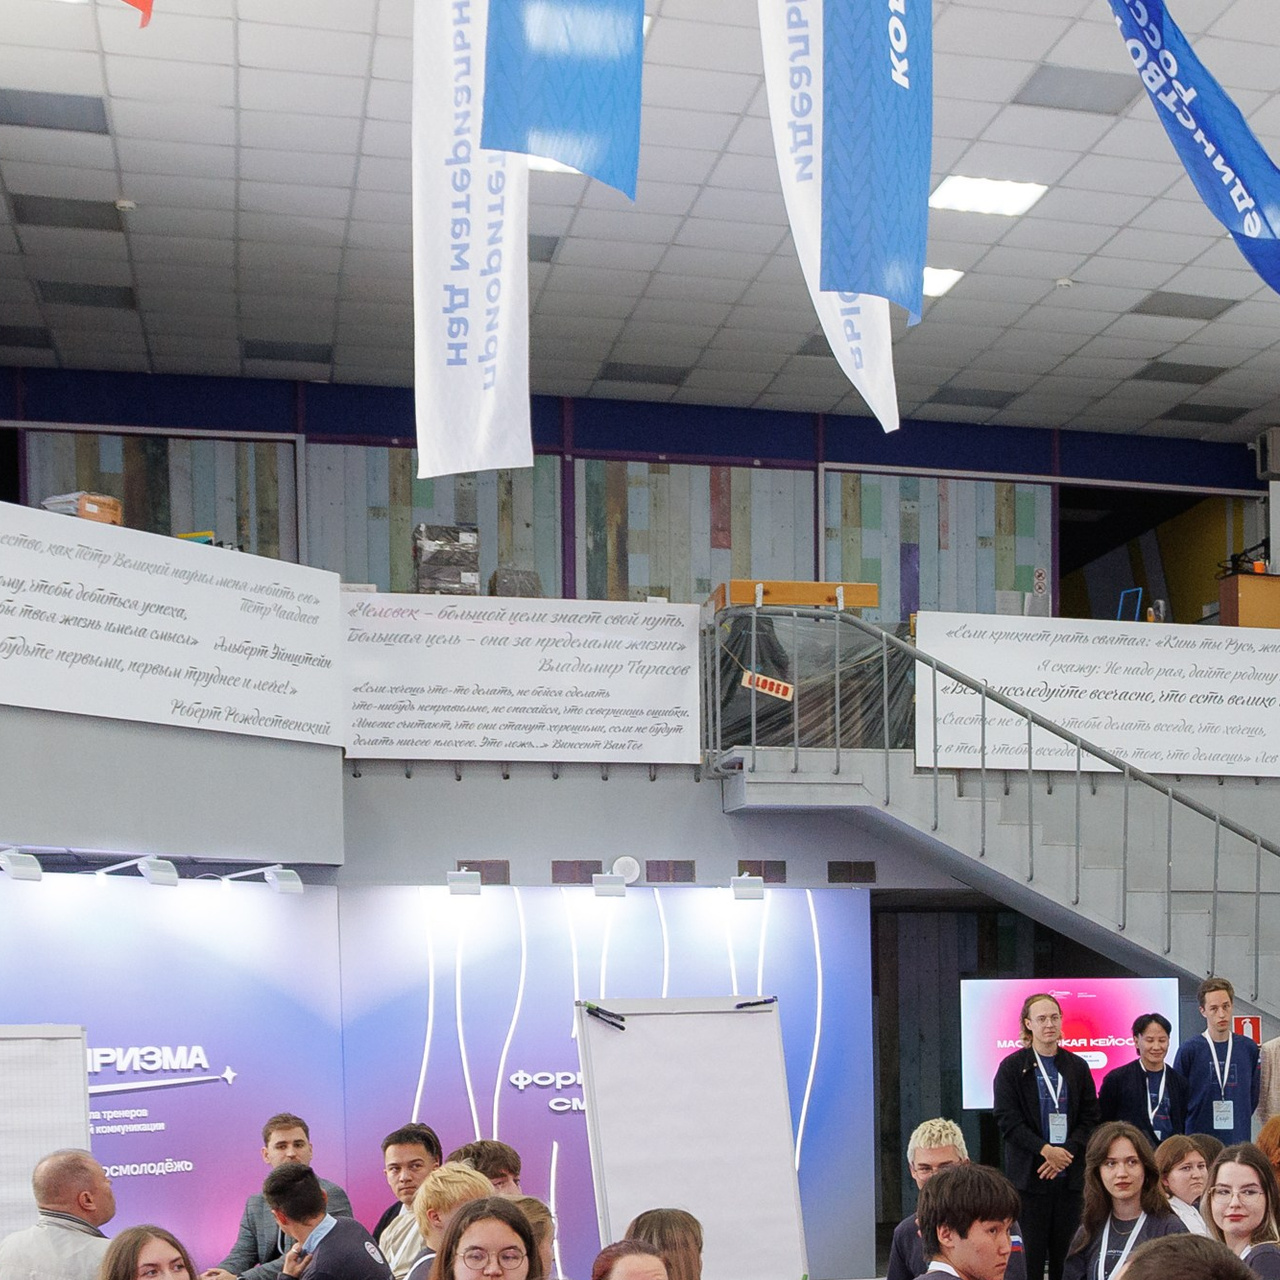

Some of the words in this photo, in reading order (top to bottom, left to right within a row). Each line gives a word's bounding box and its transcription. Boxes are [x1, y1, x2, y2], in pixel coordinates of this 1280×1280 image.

[112, 551, 170, 576] Великий
[171, 566, 214, 586] научил
[215, 576, 249, 592] меня
[29, 578, 73, 598] чтобы
[75, 582, 139, 610] добиться
[138, 600, 188, 622] успеха,
[18, 604, 57, 624] твоя
[58, 613, 102, 631] жизнь
[103, 621, 148, 638] имела
[271, 602, 320, 626] Чаадаев
[437, 604, 507, 625] большой
[508, 610, 548, 626] цели
[550, 611, 602, 625] знает
[604, 611, 643, 627] свой
[641, 613, 686, 632] путь.
[347, 627, 422, 647] Большая
[424, 632, 462, 648] цель
[480, 634, 510, 647] она
[511, 635, 532, 648] за
[535, 631, 625, 652] пределами
[988, 629, 1051, 644] крикнет
[1050, 631, 1089, 646] рать
[1200, 638, 1223, 650] ты
[213, 635, 270, 661] Альберт
[269, 643, 333, 669] Эйнштейн
[55, 649, 125, 673] первыми,
[127, 659, 182, 680] первым
[183, 665, 241, 688] труднее
[537, 656, 624, 680] Владимир
[627, 659, 692, 680] Тарасов
[1037, 659, 1051, 672] Я
[1103, 660, 1122, 675] Не
[1123, 660, 1155, 677] надо
[1189, 663, 1232, 680] дайте
[1229, 665, 1279, 686] родину
[565, 685, 611, 699] сделать
[1158, 688, 1188, 703] что
[1188, 691, 1225, 706] есть
[1227, 693, 1277, 708] велико
[170, 698, 222, 724] Роберт
[223, 705, 332, 736] Рождественский
[476, 722, 498, 731] они
[997, 717, 1012, 728] не
[1104, 715, 1151, 732] делать
[1198, 722, 1221, 735] что
[353, 733, 395, 747] делать
[552, 738, 602, 750] Винсент
[1035, 742, 1077, 757] всегда
[1166, 749, 1190, 761] что
[1255, 750, 1279, 764] Лев
[101, 1109, 149, 1121] тренеров
